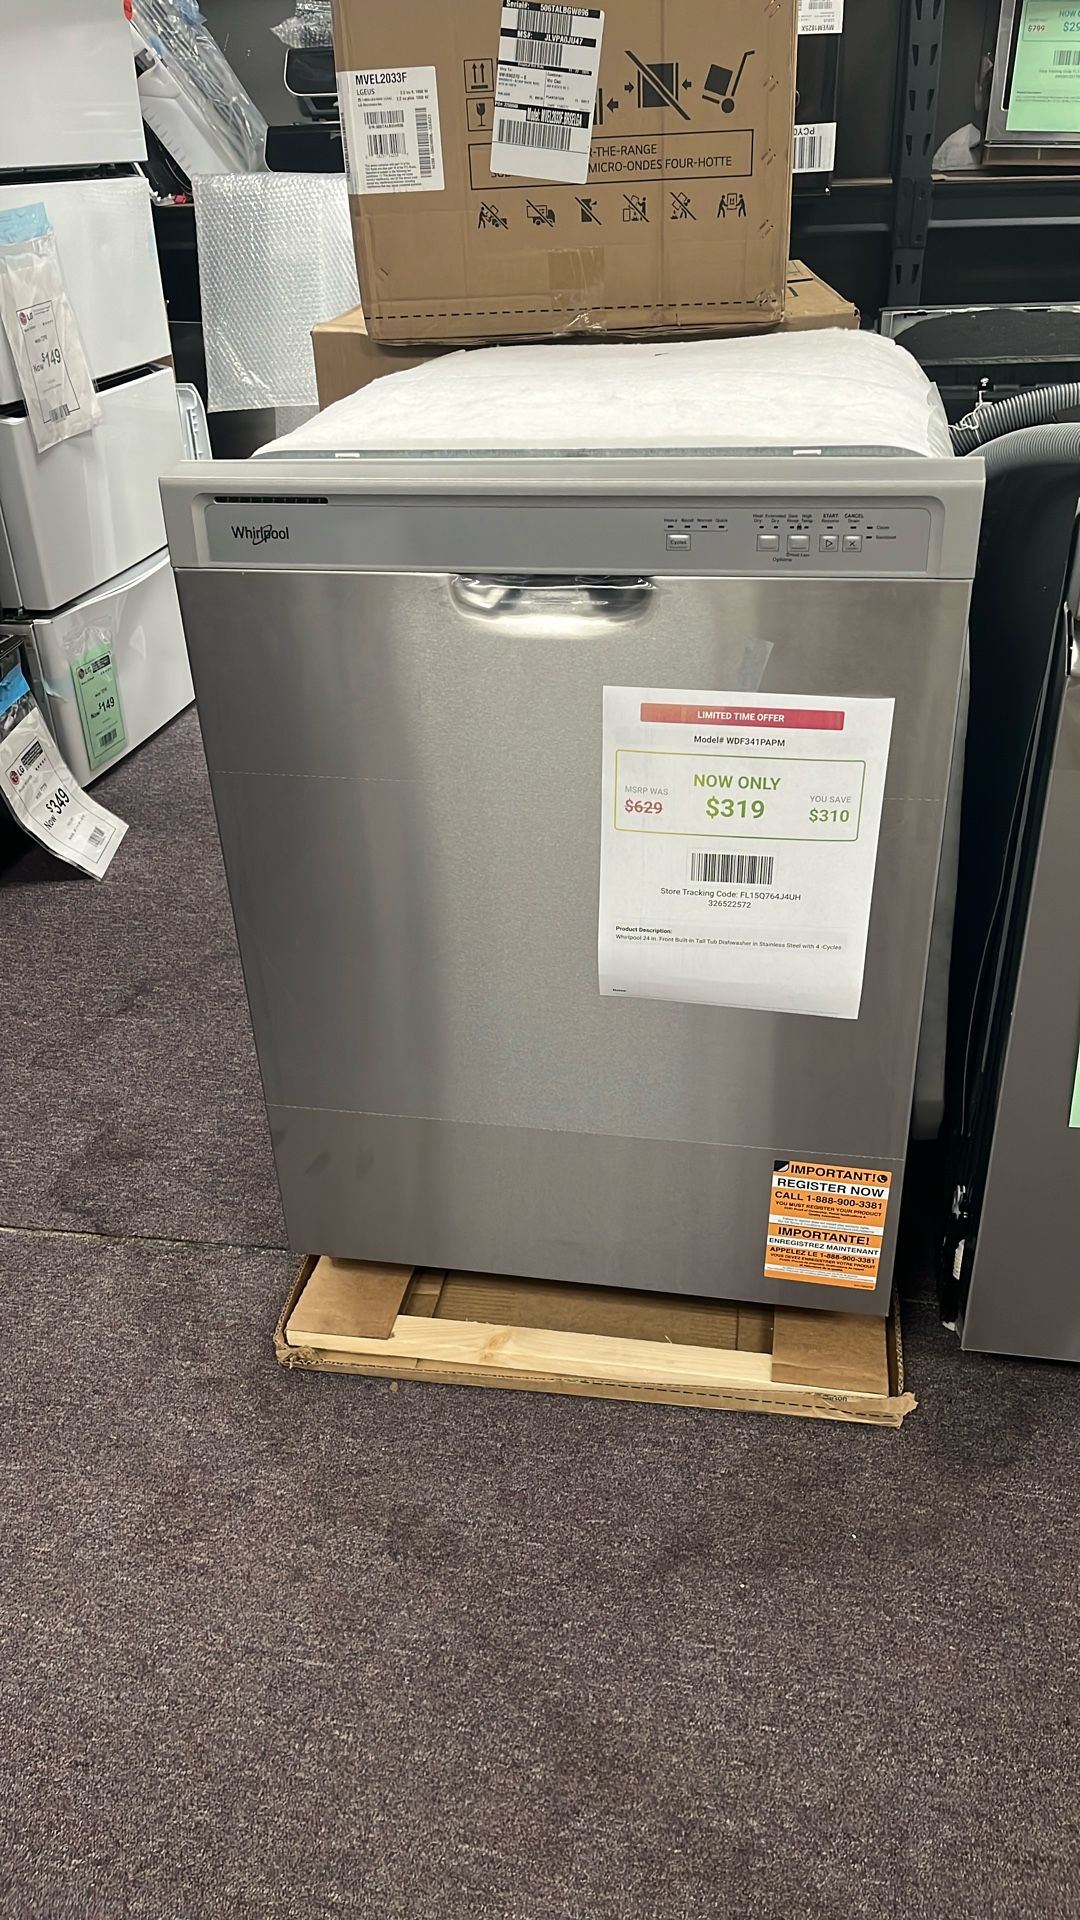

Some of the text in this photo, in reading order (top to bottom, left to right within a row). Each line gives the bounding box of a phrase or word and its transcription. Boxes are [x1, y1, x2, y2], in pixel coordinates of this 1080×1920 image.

[506, 0, 530, 10] Serial#:
[356, 72, 407, 85] MVEL2033F
[665, 156, 732, 170] FOUR-HOTTE
[42, 348, 61, 367] $149
[231, 524, 289, 545] Whirlpool
[99, 697, 114, 711] $149
[697, 711, 785, 722] LIMITED TIME OFFER
[694, 735, 786, 747] Model# WDF341PAPM
[694, 773, 781, 791] NOW ONLY
[624, 785, 669, 796] MSRP WAS
[46, 788, 70, 814] $349
[624, 795, 852, 819] $629 $319 YOU SAVE
[809, 808, 849, 823] $310
[661, 887, 681, 896] Store
[683, 888, 714, 898] Tracking
[716, 890, 738, 898] Code:
[708, 900, 752, 908] 326522572
[791, 1164, 876, 1182] IMPORTANT!
[777, 1178, 884, 1198] REGISTER NOW
[775, 1191, 882, 1210] CALL 1-888-900-3381
[778, 1227, 870, 1245] IMPORTANTE!
[769, 1238, 879, 1255] ENREGISTREZ MAINTENANT
[770, 1246, 806, 1256] APPELEZ
